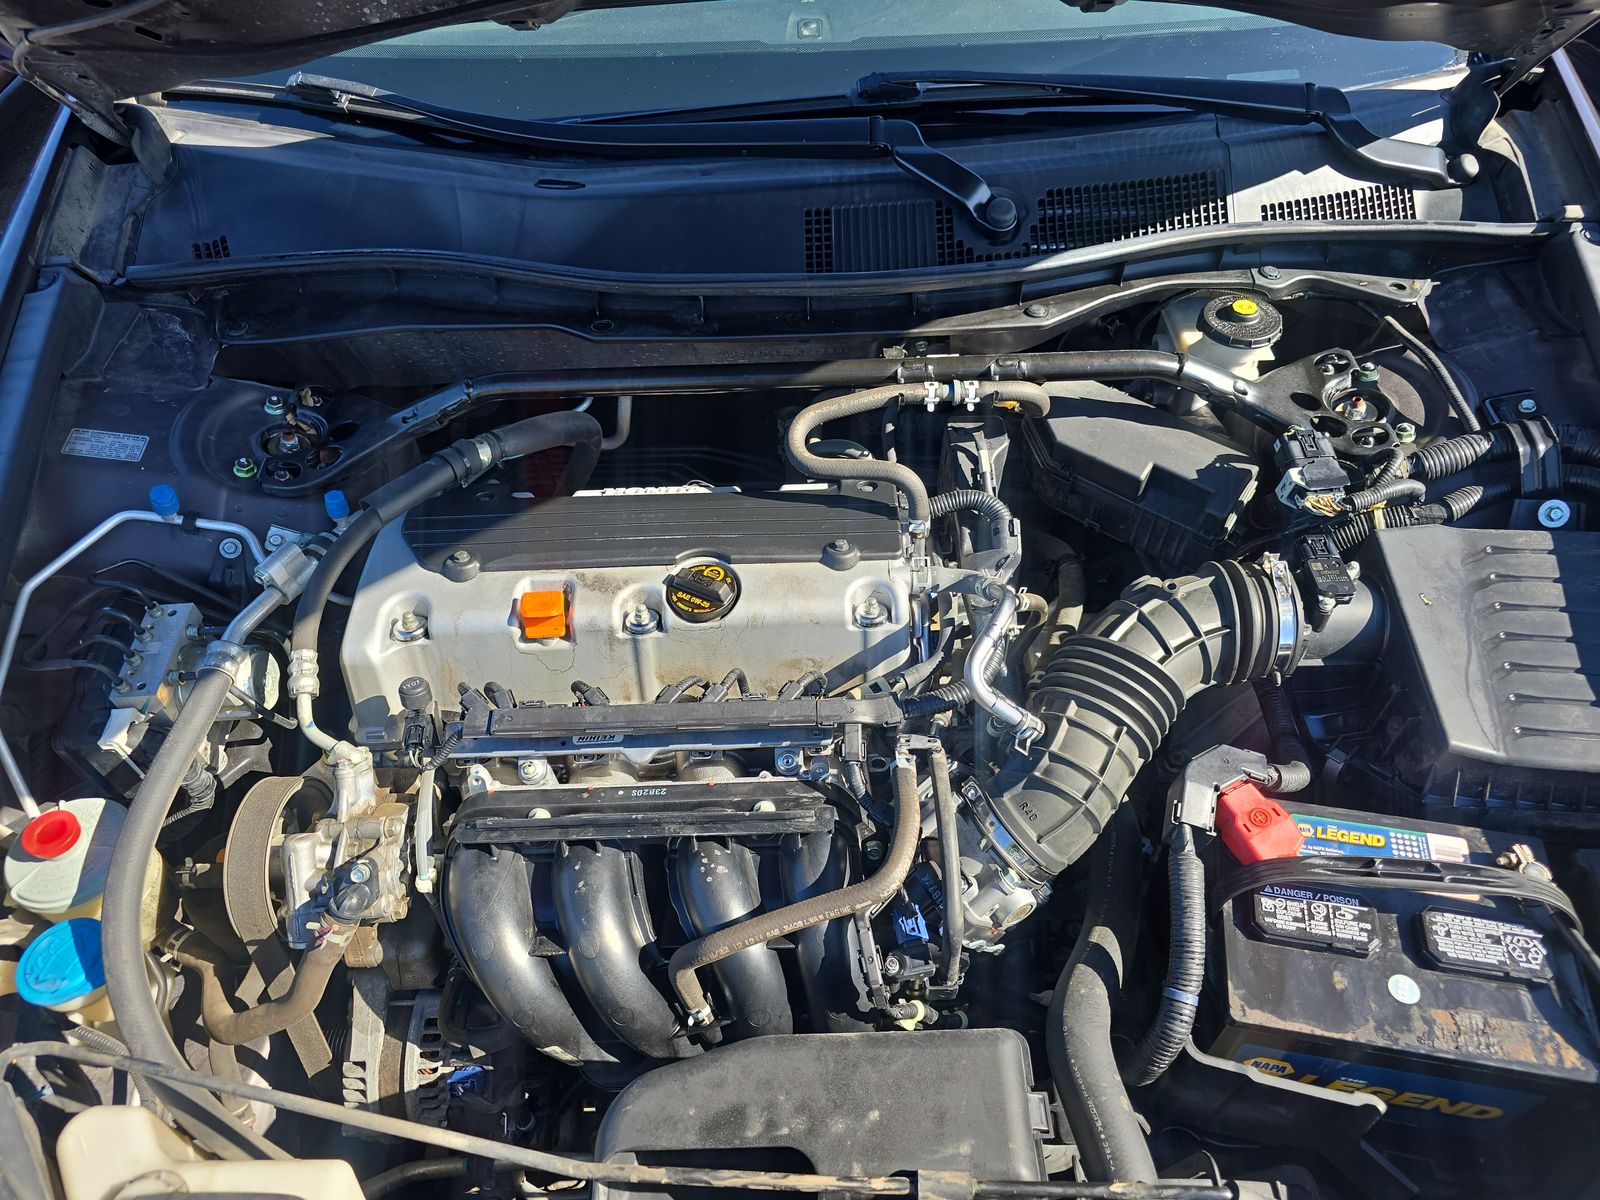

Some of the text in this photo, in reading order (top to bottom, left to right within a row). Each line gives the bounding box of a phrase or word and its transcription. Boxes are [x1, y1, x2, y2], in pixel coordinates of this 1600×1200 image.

[676, 591, 711, 608] SAE 0W-20
[1019, 801, 1038, 822] R40
[1316, 825, 1386, 848] LEGEND
[1273, 886, 1313, 900] DANGER
[1323, 894, 1359, 906] POISON
[825, 905, 852, 919] ENGINE
[1250, 1060, 1289, 1074] NAPA
